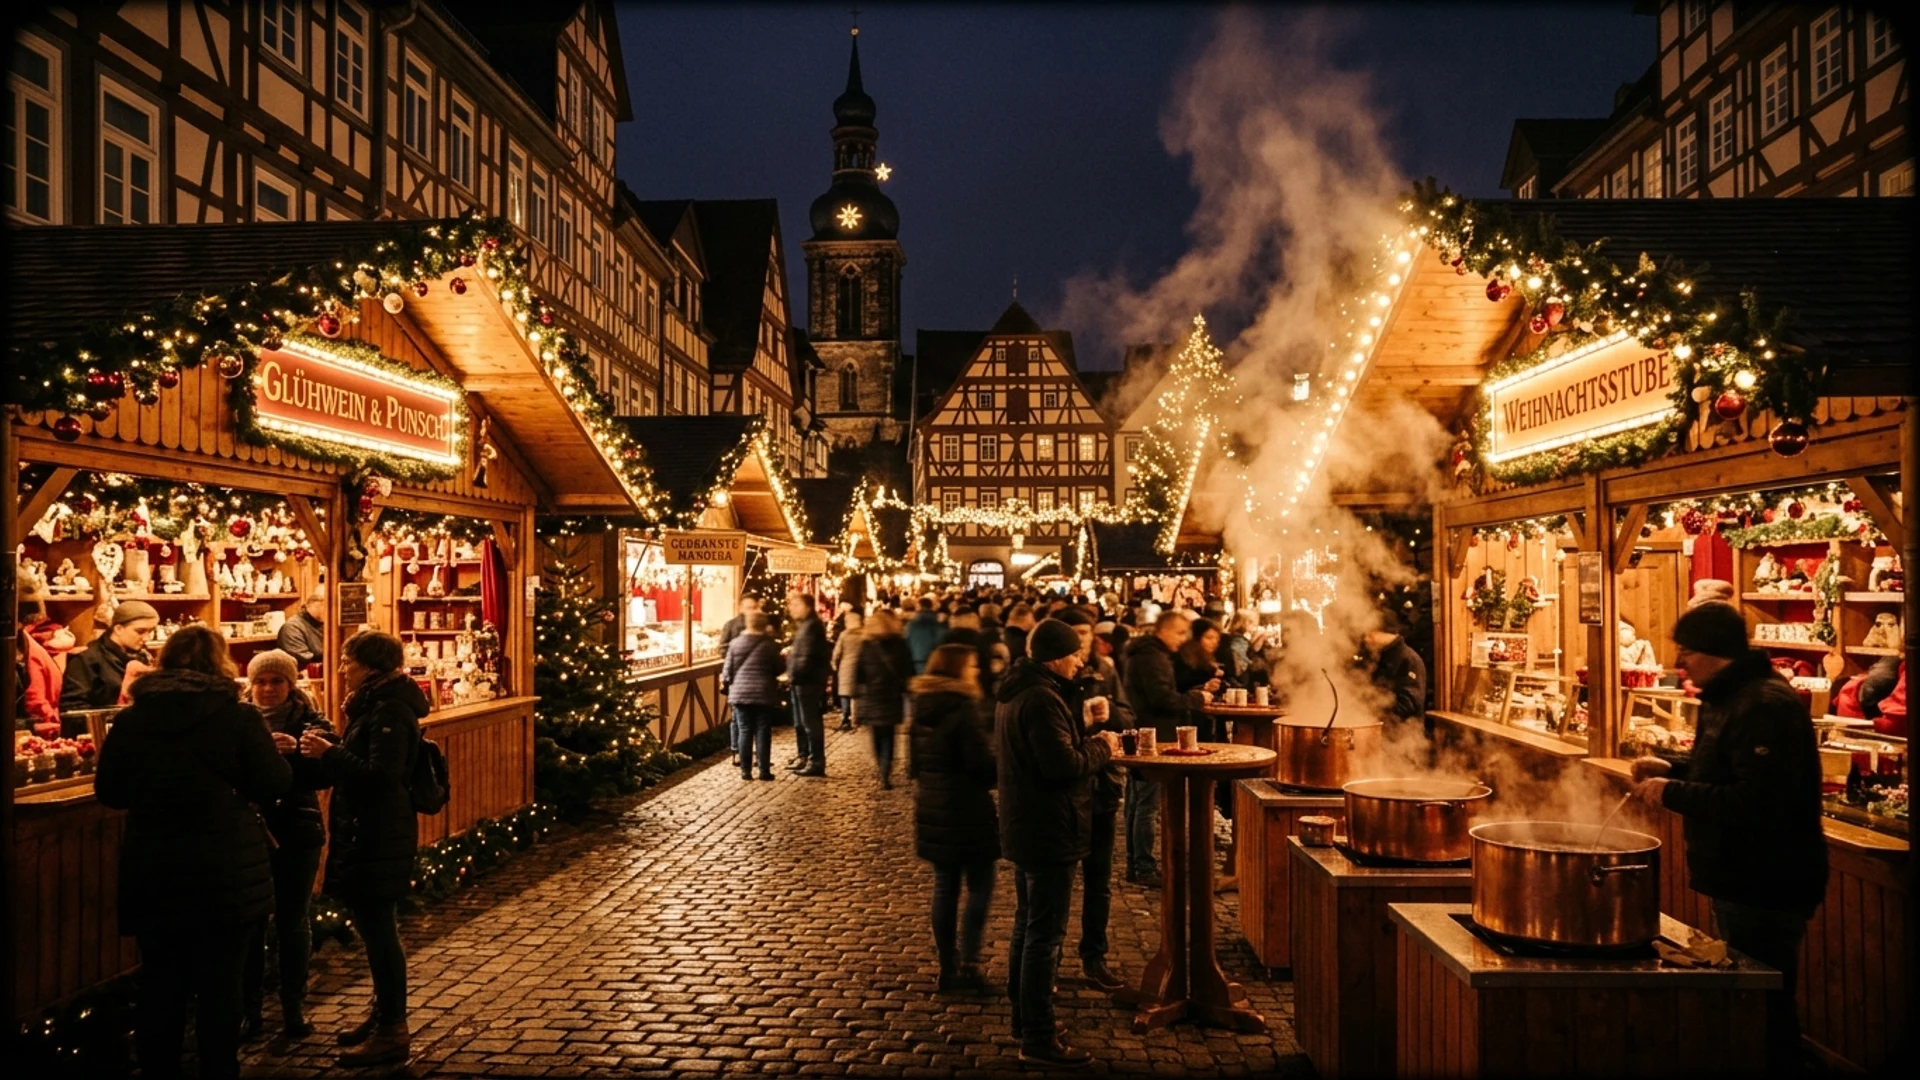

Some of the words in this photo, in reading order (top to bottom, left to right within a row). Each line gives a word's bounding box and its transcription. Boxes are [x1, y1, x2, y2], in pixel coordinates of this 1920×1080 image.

[262, 361, 366, 423] GLÜHWEIN
[370, 398, 382, 426] &
[1503, 351, 1671, 434] WEIHNACHTSSTUBE
